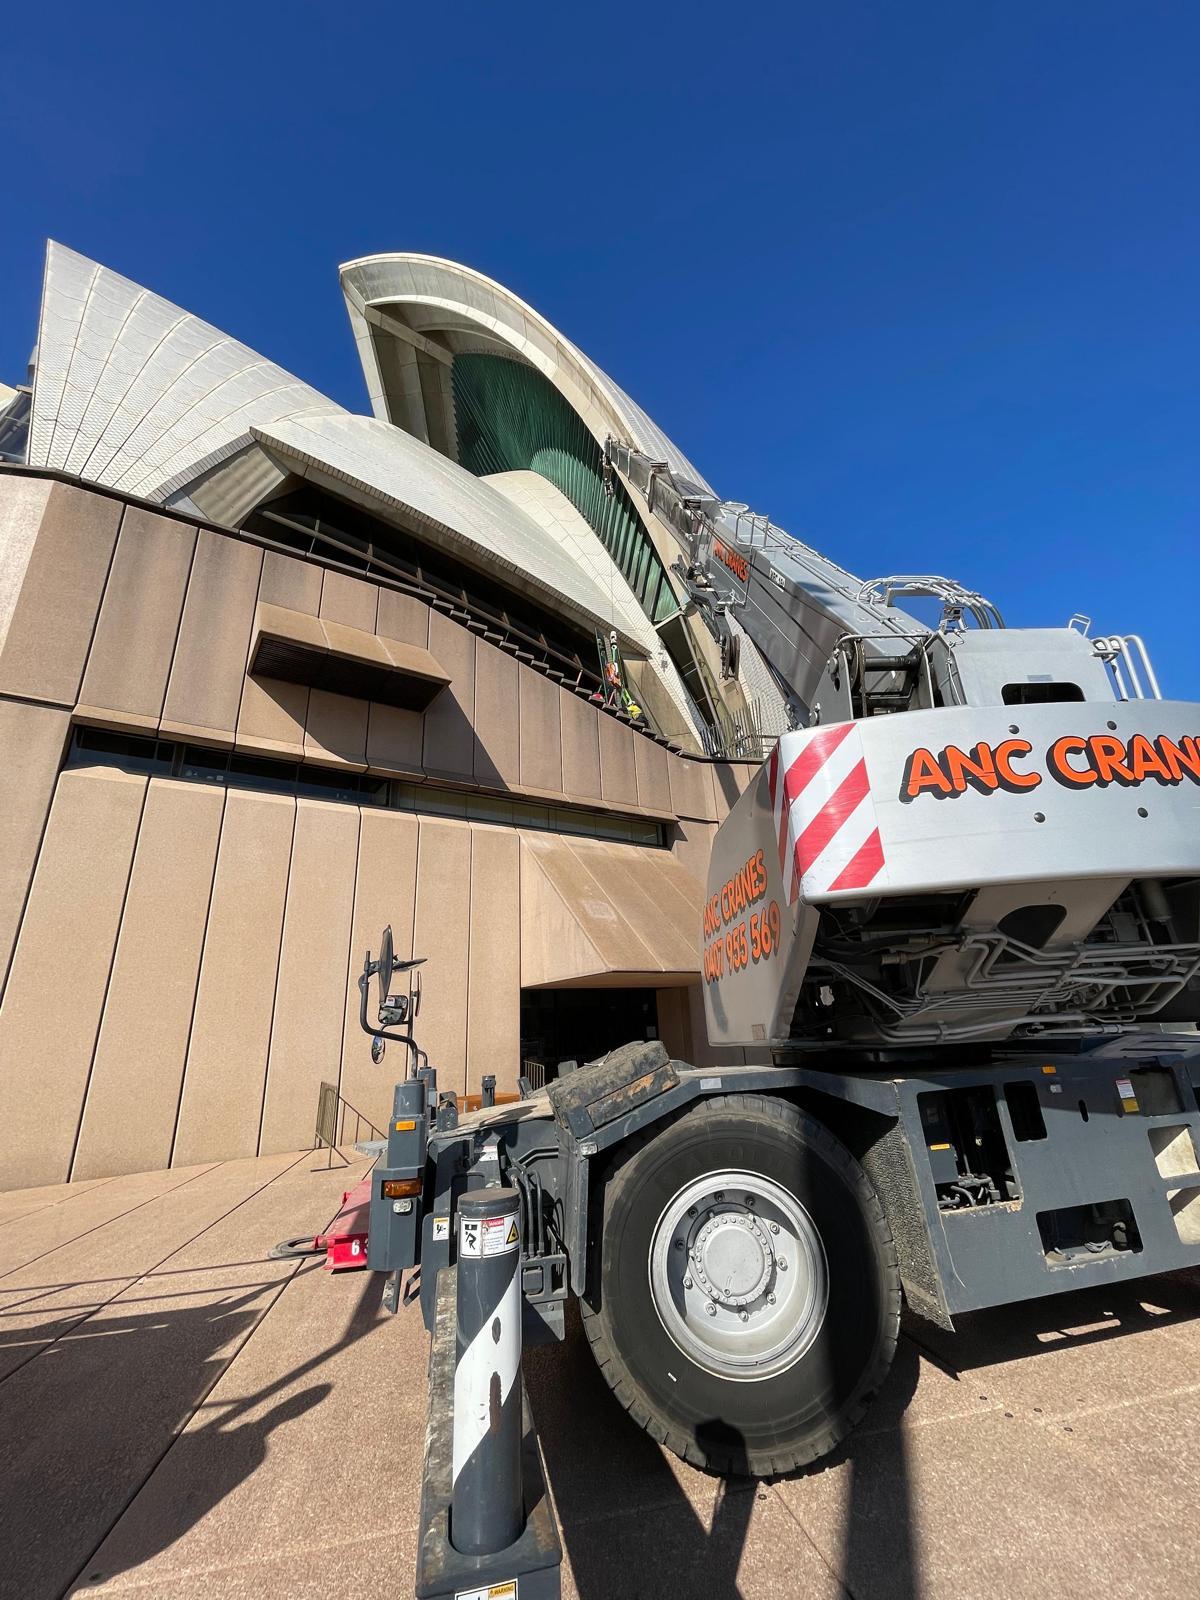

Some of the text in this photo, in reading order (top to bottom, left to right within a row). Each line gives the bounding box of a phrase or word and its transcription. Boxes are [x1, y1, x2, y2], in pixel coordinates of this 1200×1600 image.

[899, 734, 1200, 804] ANC CRAN
[703, 849, 767, 940] ANC CRANES
[703, 901, 781, 985] 0407 955 569
